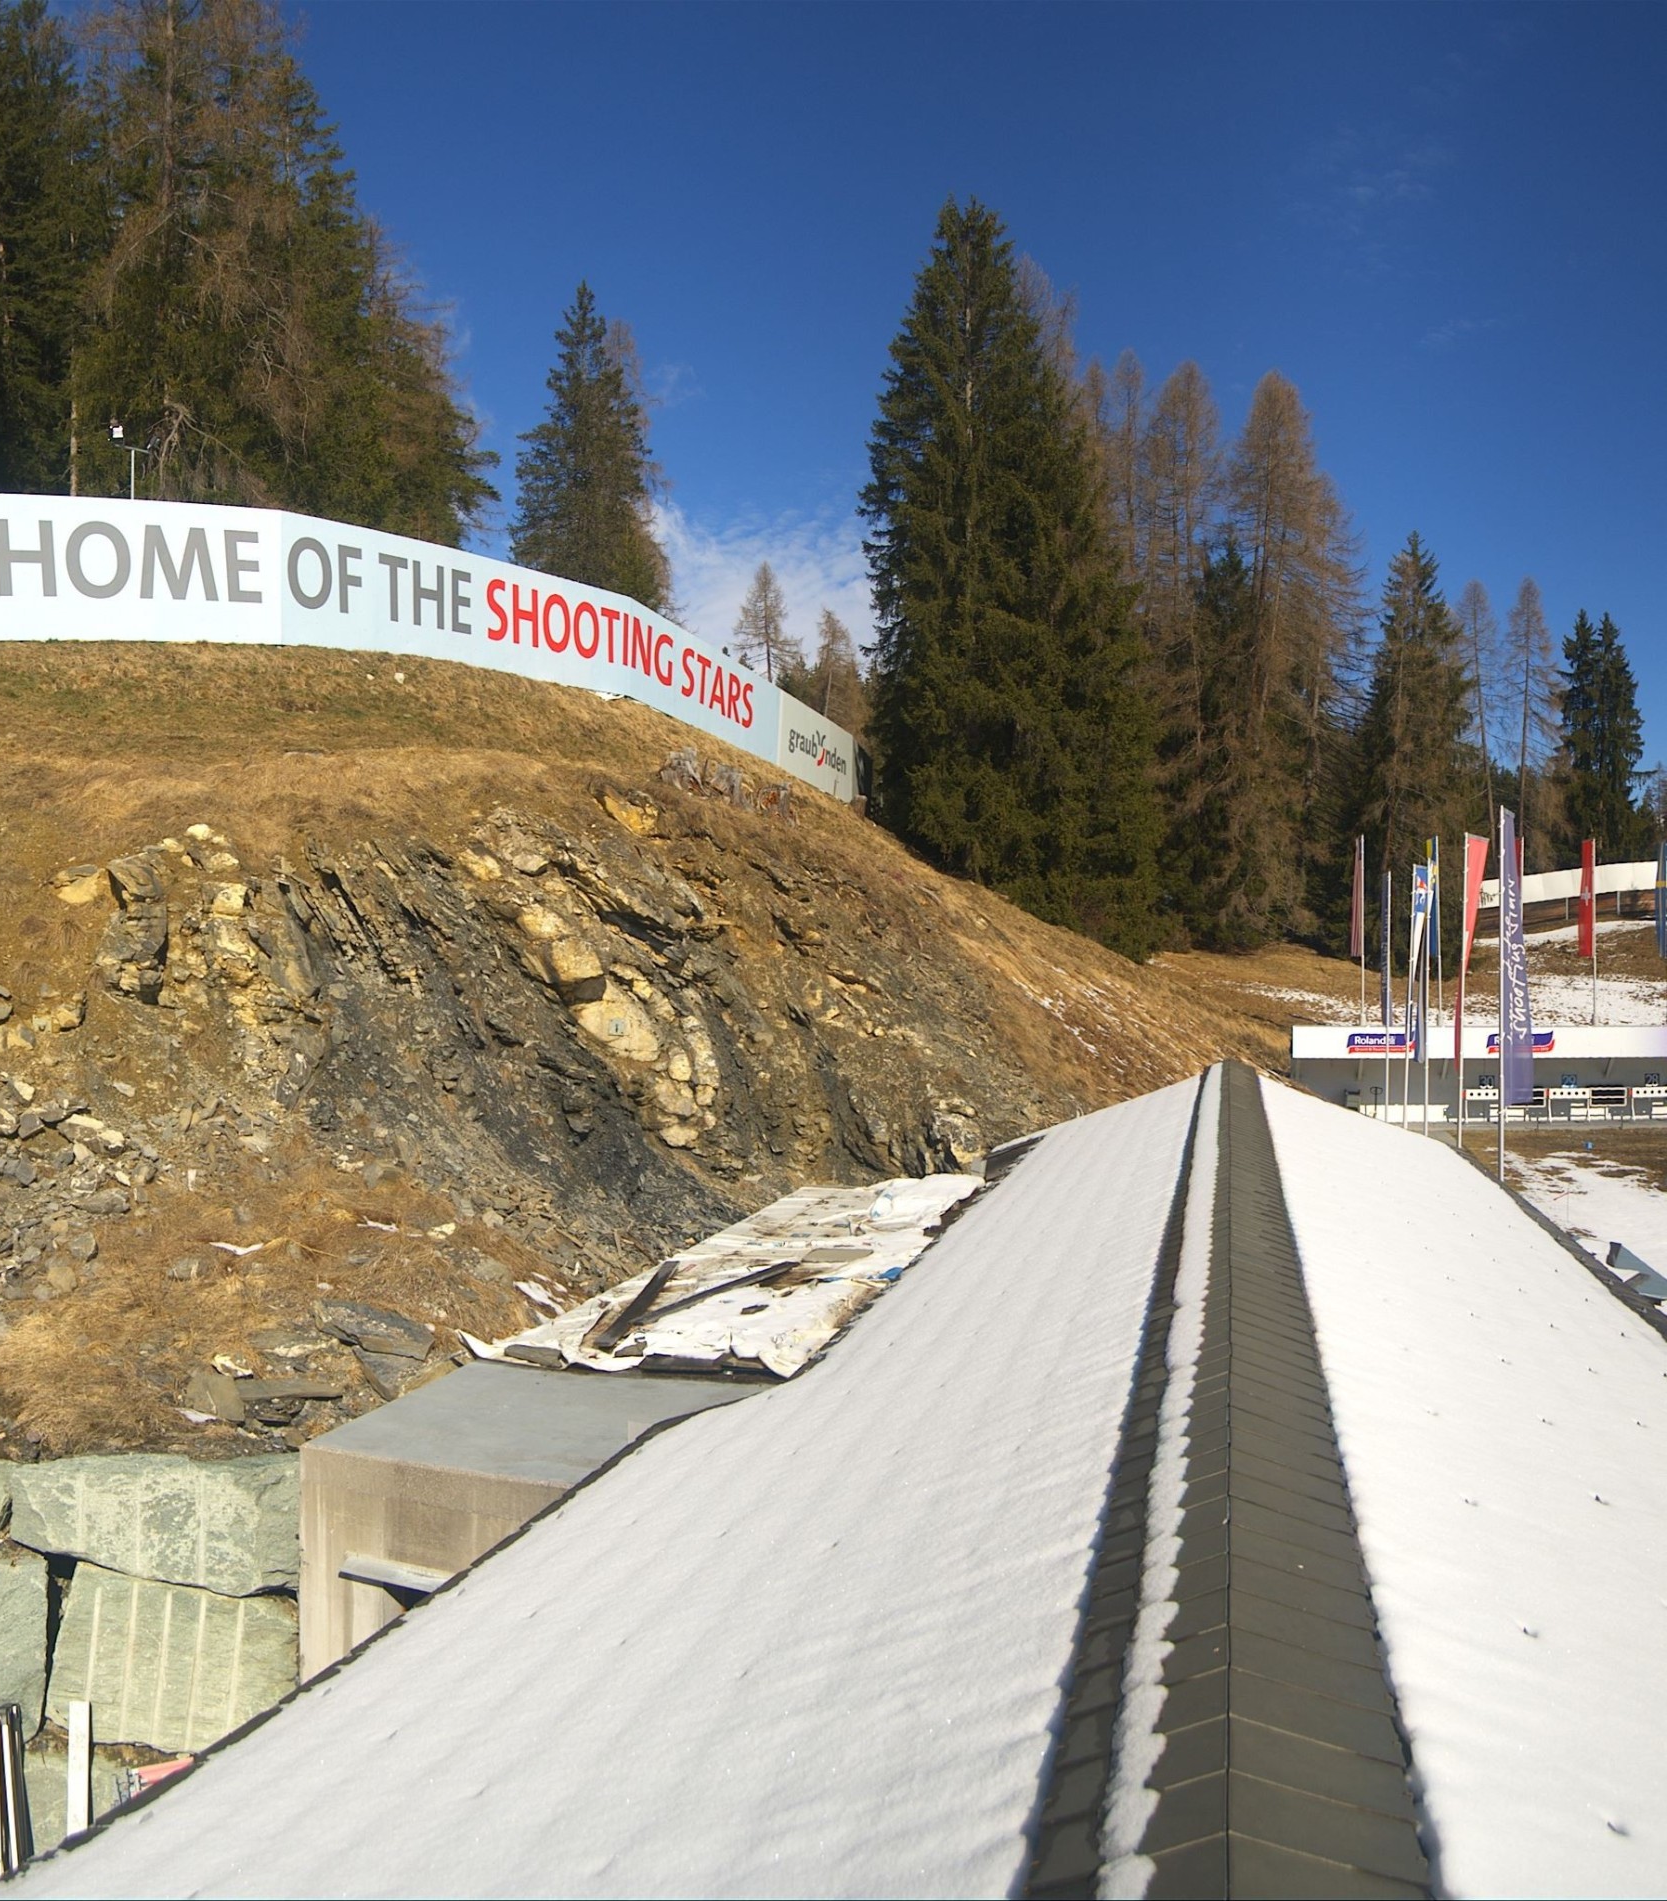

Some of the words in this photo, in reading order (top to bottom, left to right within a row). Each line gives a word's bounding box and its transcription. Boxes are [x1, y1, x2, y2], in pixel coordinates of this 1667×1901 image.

[286, 536, 364, 614] OF
[378, 551, 474, 636] THE
[486, 578, 673, 687] SHOOTING
[680, 647, 754, 729] STARS
[1355, 1036, 1386, 1045] Roland
